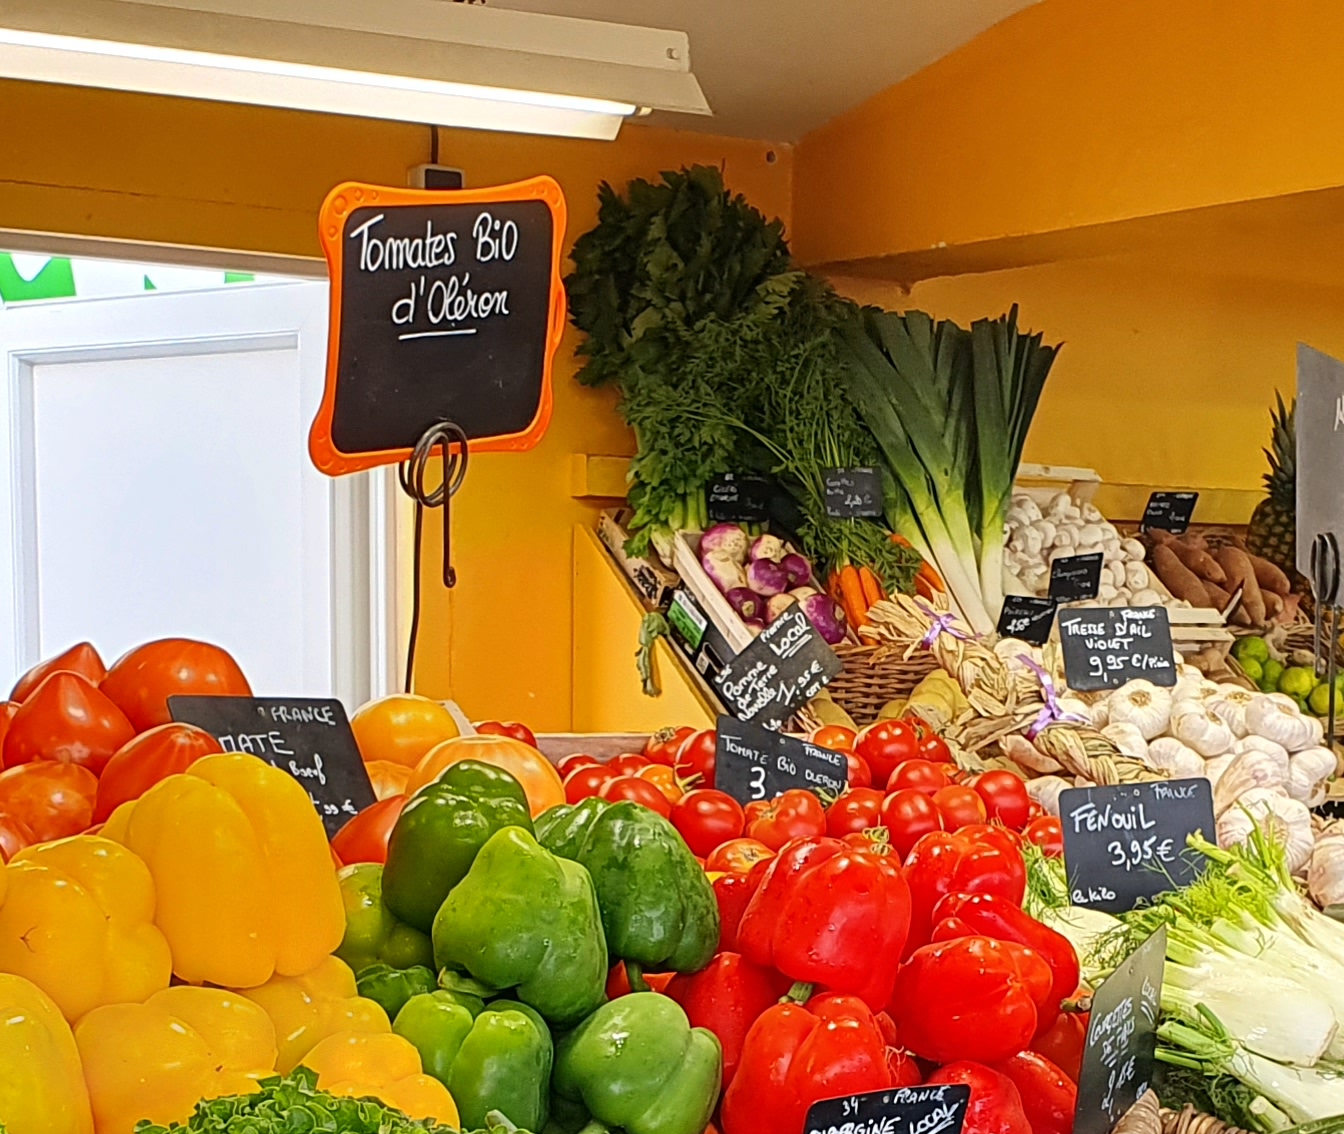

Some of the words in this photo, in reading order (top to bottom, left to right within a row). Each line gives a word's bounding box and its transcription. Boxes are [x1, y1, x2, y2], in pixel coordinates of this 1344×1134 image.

[349, 213, 457, 272] Tomates
[391, 271, 510, 325] d'Oléron
[1061, 617, 1106, 636] TRESSE
[722, 661, 768, 701] Pomme
[270, 705, 336, 726] FRANCE
[217, 730, 295, 755] MATE
[719, 734, 769, 765] TOMATE
[1107, 835, 1175, 871] 3,95€
[893, 1084, 952, 1105] FRANCE
